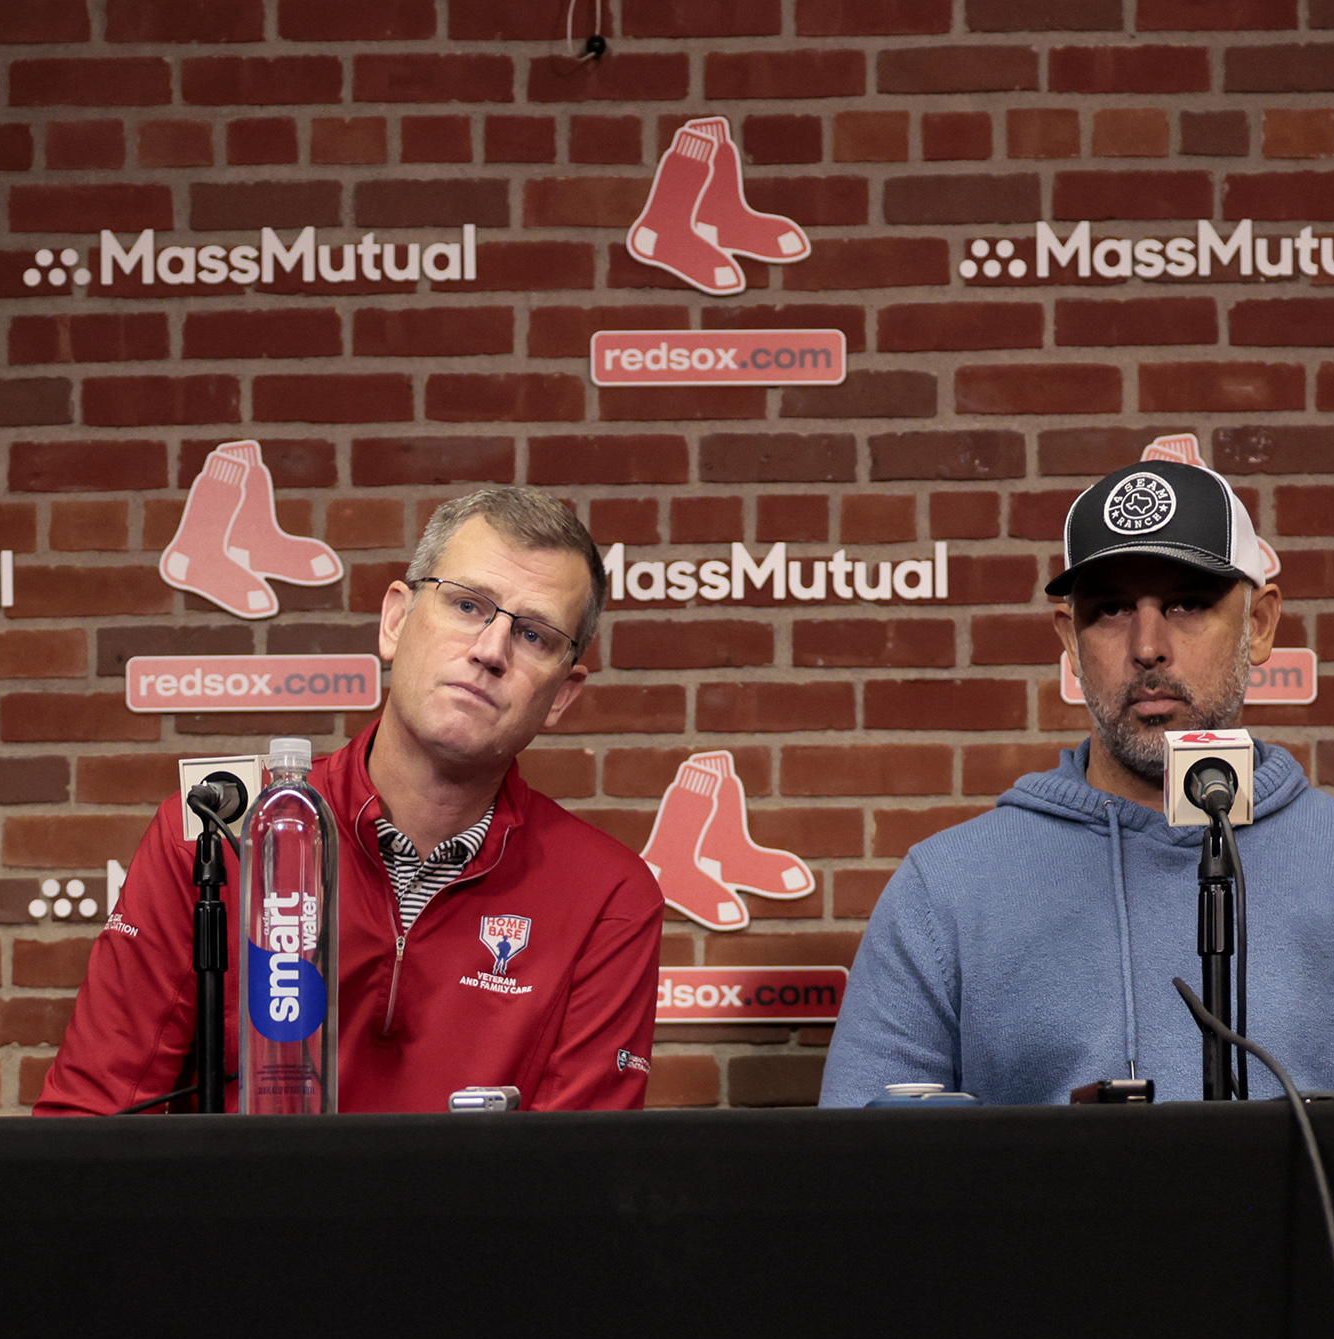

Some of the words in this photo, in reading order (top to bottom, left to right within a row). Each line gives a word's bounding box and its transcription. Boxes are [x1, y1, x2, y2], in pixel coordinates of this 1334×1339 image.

[101, 224, 476, 285] MassMutual
[602, 342, 833, 373] redsox.com
[1124, 478, 1169, 500] SEAM
[1116, 512, 1162, 529] RANCH
[138, 663, 367, 698] redsox.com
[300, 892, 318, 951] water
[487, 917, 527, 931] HOME
[488, 926, 522, 940] BASE
[263, 891, 301, 1023] smart
[459, 975, 479, 987] AND
[479, 980, 511, 994] FAMILY
[510, 985, 533, 994] CARE
[477, 970, 517, 986] VETERAN
[656, 978, 837, 1008] dsox.com
